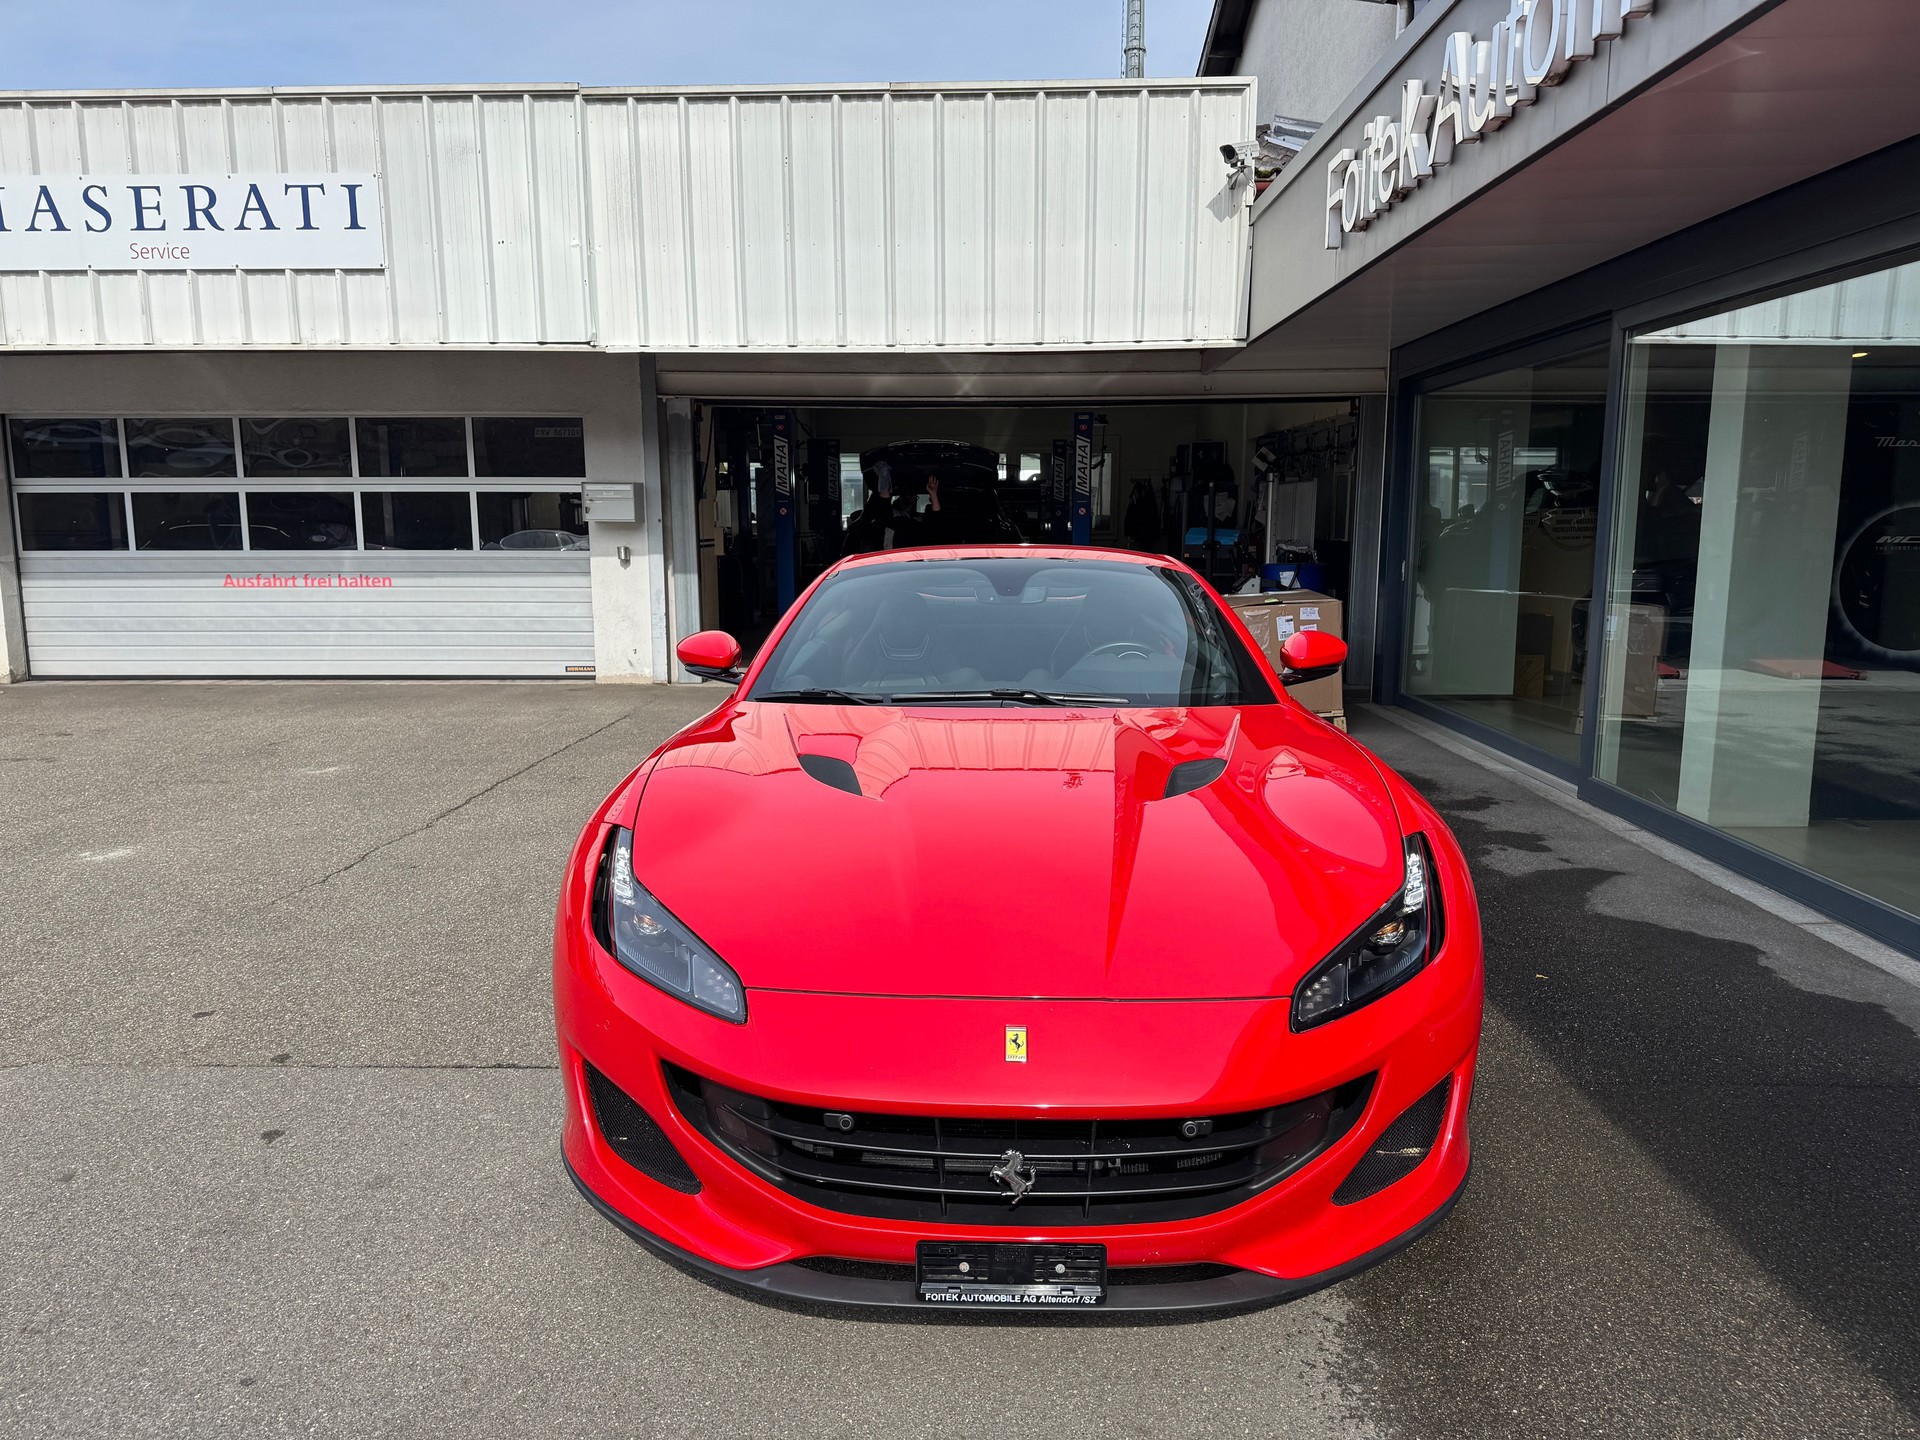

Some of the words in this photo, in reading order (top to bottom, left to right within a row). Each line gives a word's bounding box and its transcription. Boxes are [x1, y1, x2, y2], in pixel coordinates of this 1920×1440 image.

[1325, 80, 1433, 250] Foitek
[130, 242, 191, 260] Service
[775, 442, 789, 492] MAHA
[828, 460, 839, 498] MAHA
[1053, 460, 1065, 498] MAHA
[1076, 442, 1090, 492] MAHA
[223, 574, 297, 588] Ausfahrt
[303, 574, 332, 588] frei
[338, 574, 392, 588] halten
[925, 1293, 959, 1302] FOITEK
[959, 1294, 1021, 1303] AUTOMOBILE
[1022, 1295, 1037, 1303] AG
[1038, 1295, 1080, 1304] Altendorf
[1080, 1295, 1097, 1304] /SZ
